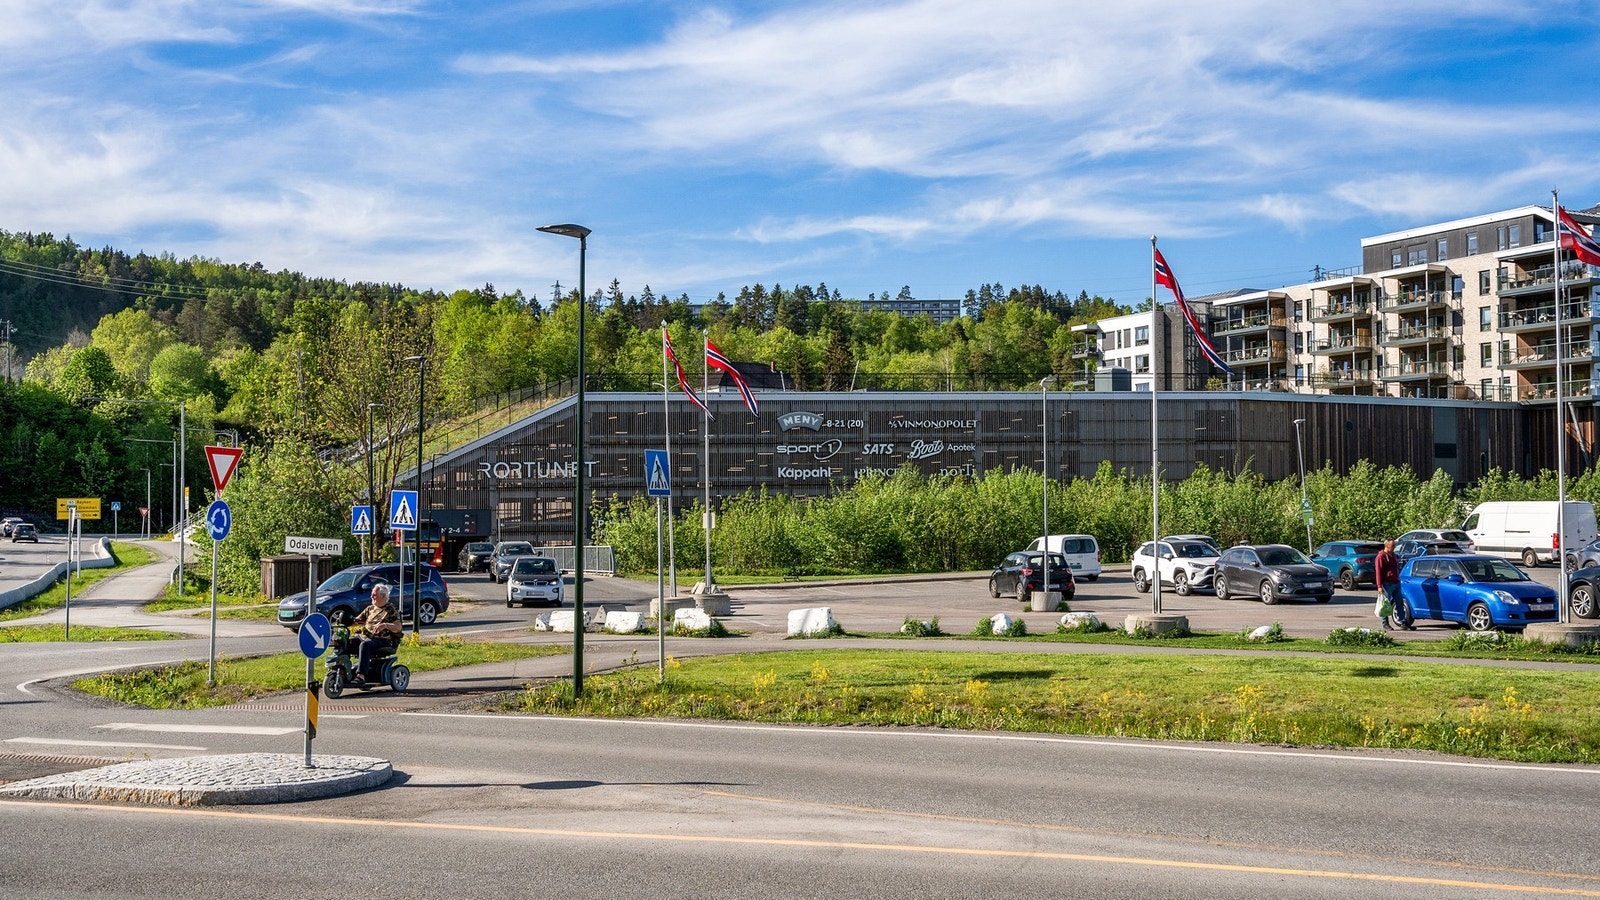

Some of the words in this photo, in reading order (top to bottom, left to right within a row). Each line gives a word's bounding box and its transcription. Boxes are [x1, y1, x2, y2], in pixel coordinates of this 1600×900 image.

[782, 415, 819, 427] MENY
[847, 420, 864, 429] (20)
[897, 420, 978, 428] VINMONOPOLET
[862, 443, 894, 454] SATS
[907, 440, 944, 459] Boots
[947, 443, 976, 453] Apotek
[939, 464, 975, 476] norli
[289, 539, 339, 551] Odalsveien
